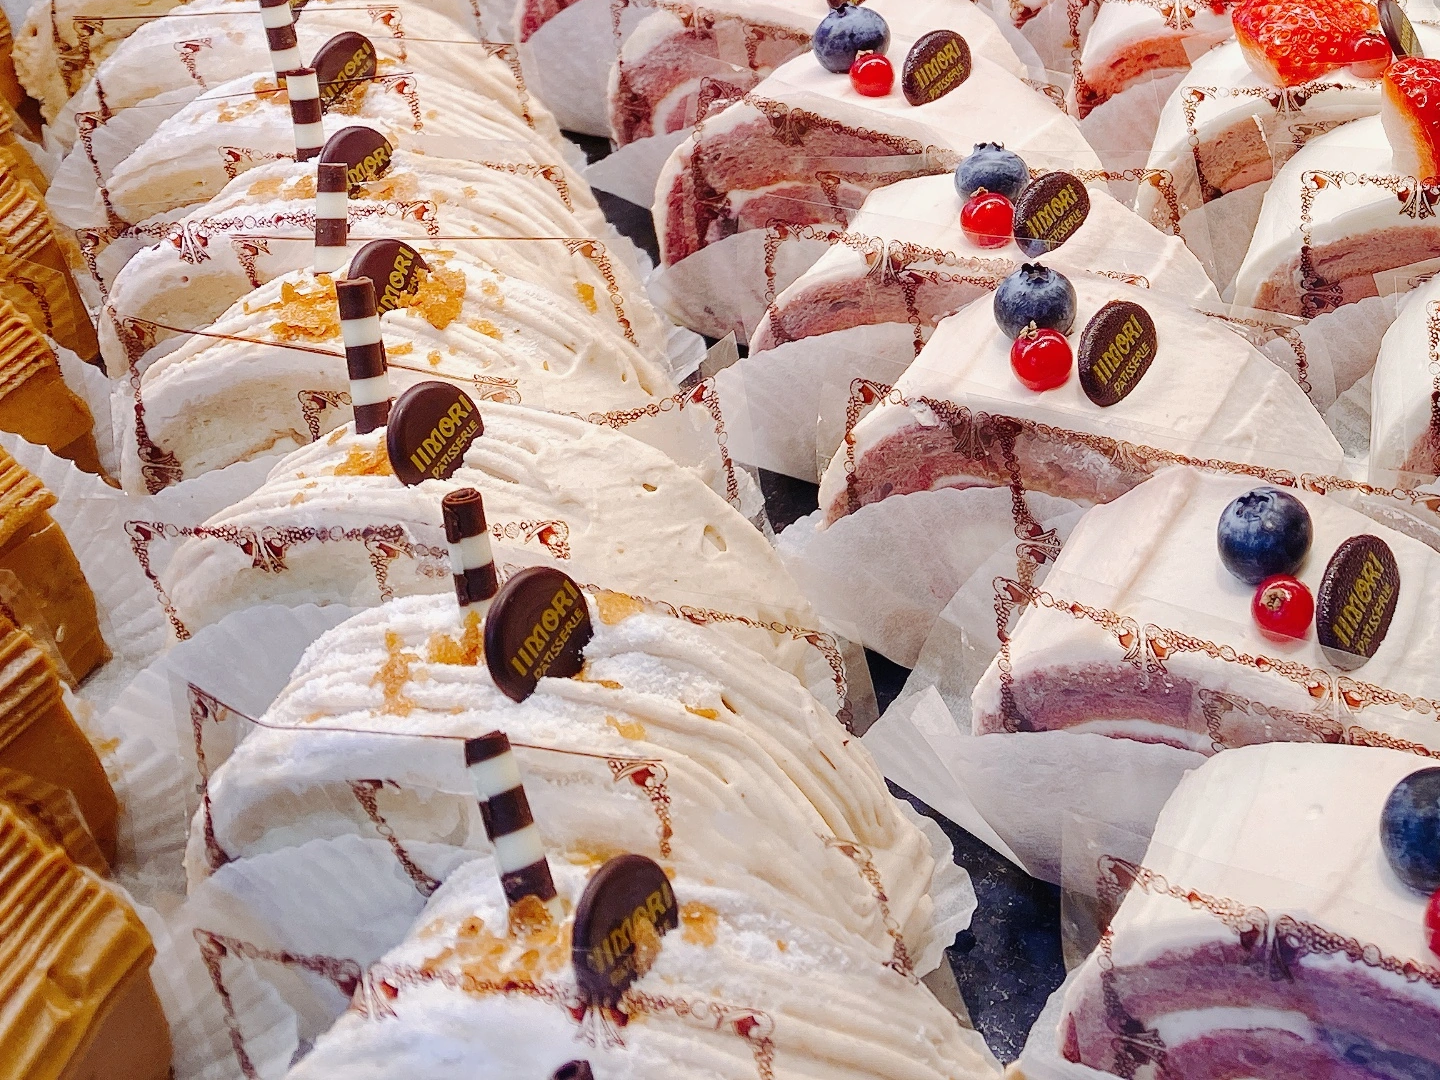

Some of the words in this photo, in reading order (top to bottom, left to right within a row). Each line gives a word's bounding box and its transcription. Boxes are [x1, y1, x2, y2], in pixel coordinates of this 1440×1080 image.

[914, 39, 961, 90] IIMORI
[1025, 183, 1078, 239] IIMORI
[1092, 313, 1143, 385] IIMORI
[1113, 342, 1150, 397] PATISSERIE
[410, 394, 473, 473] IIMORI
[432, 420, 479, 480] PATISSERIE
[510, 580, 579, 677] IIMORI
[1332, 551, 1384, 647] IIMORI
[534, 607, 586, 680] PATISSERIE
